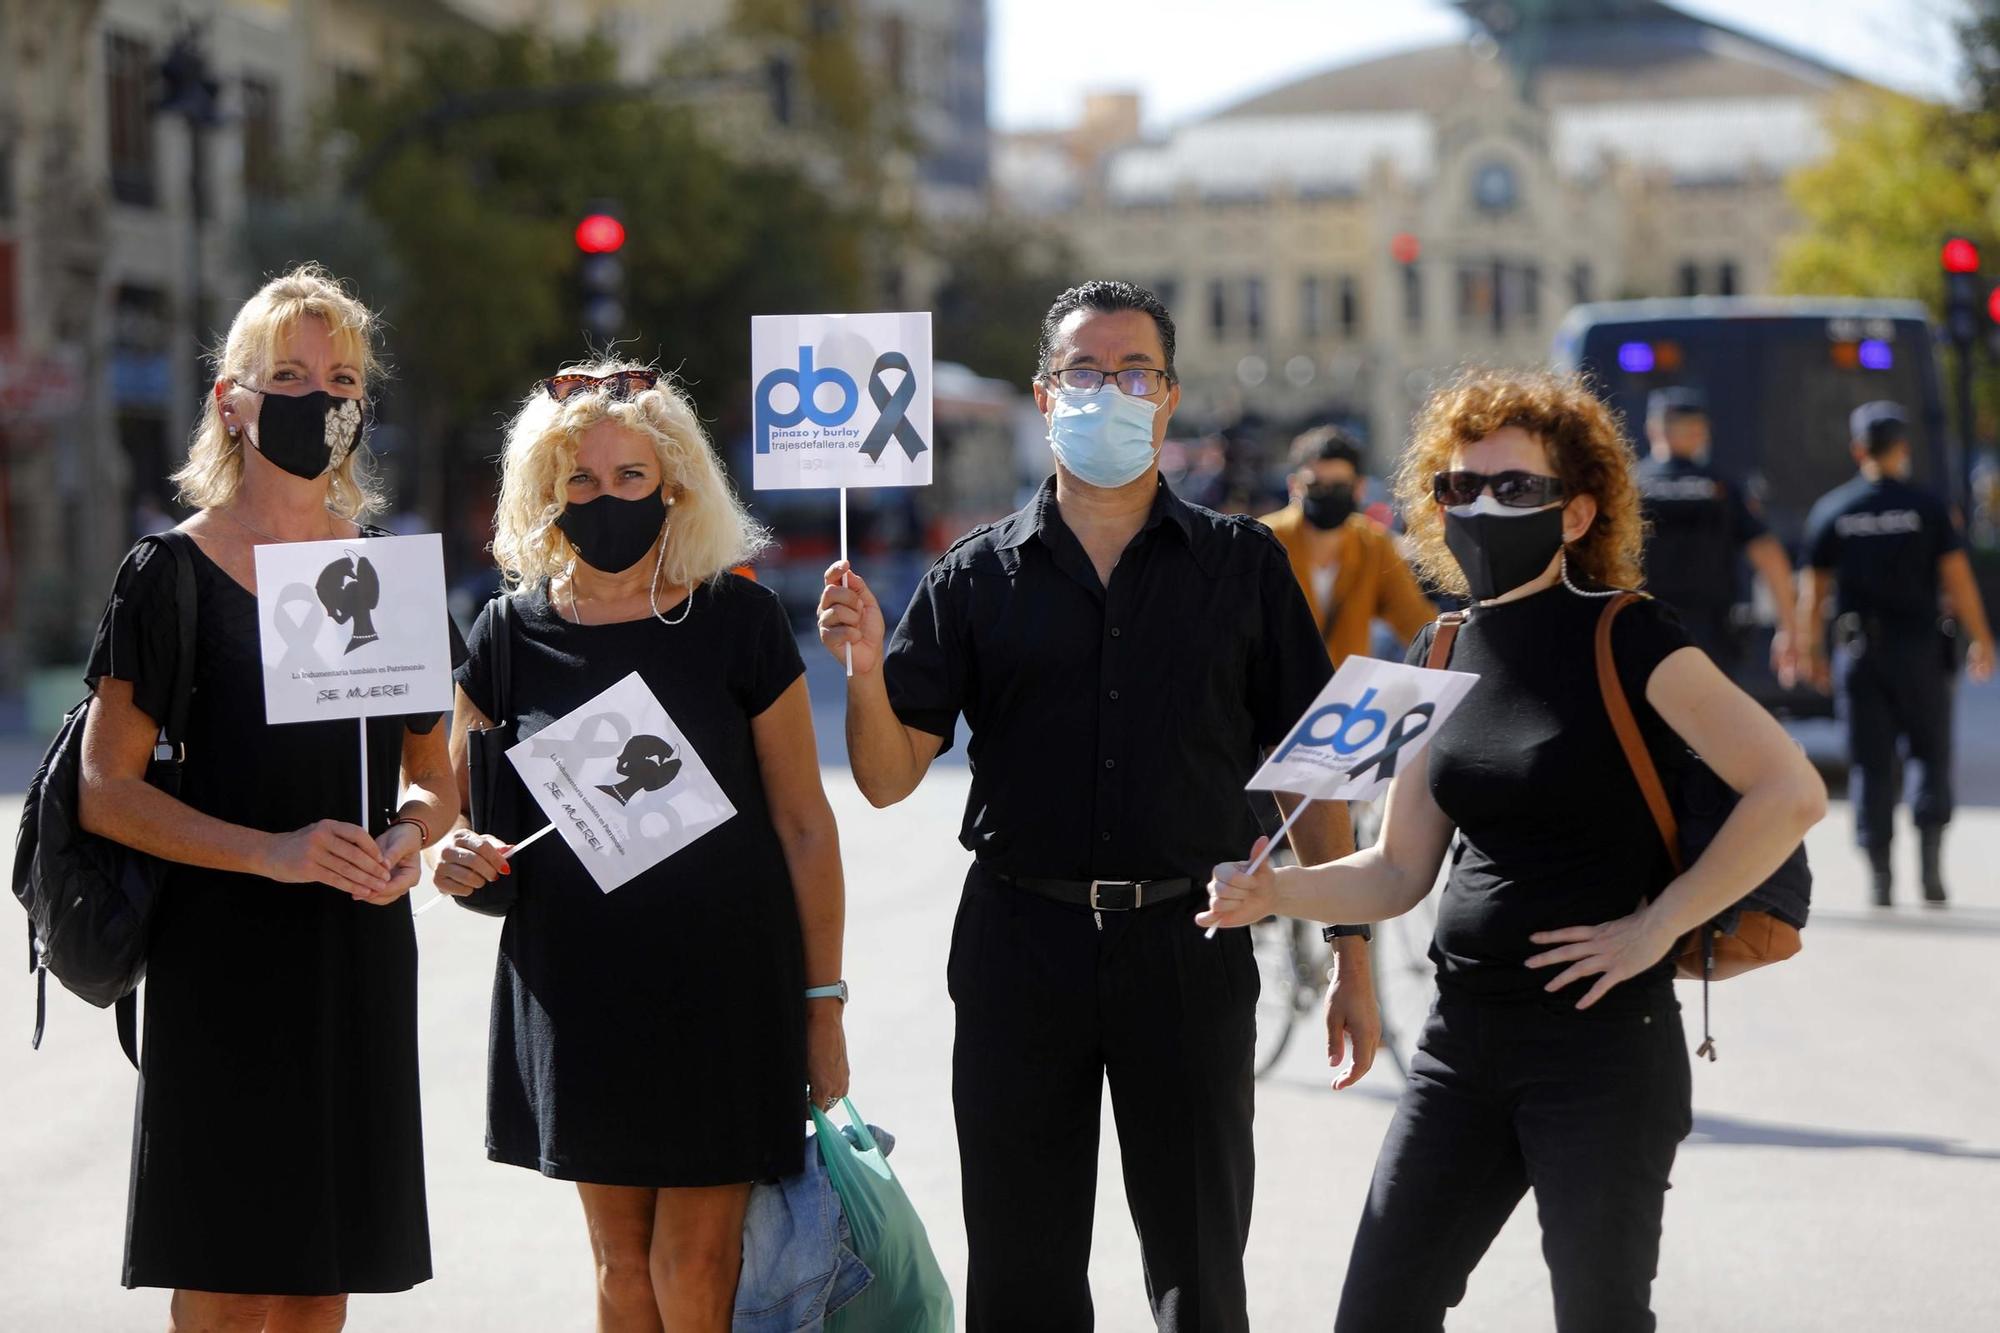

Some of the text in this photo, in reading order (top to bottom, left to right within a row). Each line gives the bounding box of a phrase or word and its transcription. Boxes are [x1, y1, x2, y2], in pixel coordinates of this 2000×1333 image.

[755, 346, 859, 454] pb
[771, 427, 860, 440] pinazo y burlay
[772, 440, 861, 451] trajesdefallera.es
[302, 669, 349, 679] Indumentaria
[387, 663, 426, 673] Patrimonio
[346, 683, 409, 699] MUERE!
[1271, 687, 1387, 763] pb
[562, 803, 605, 852] MUERE!
